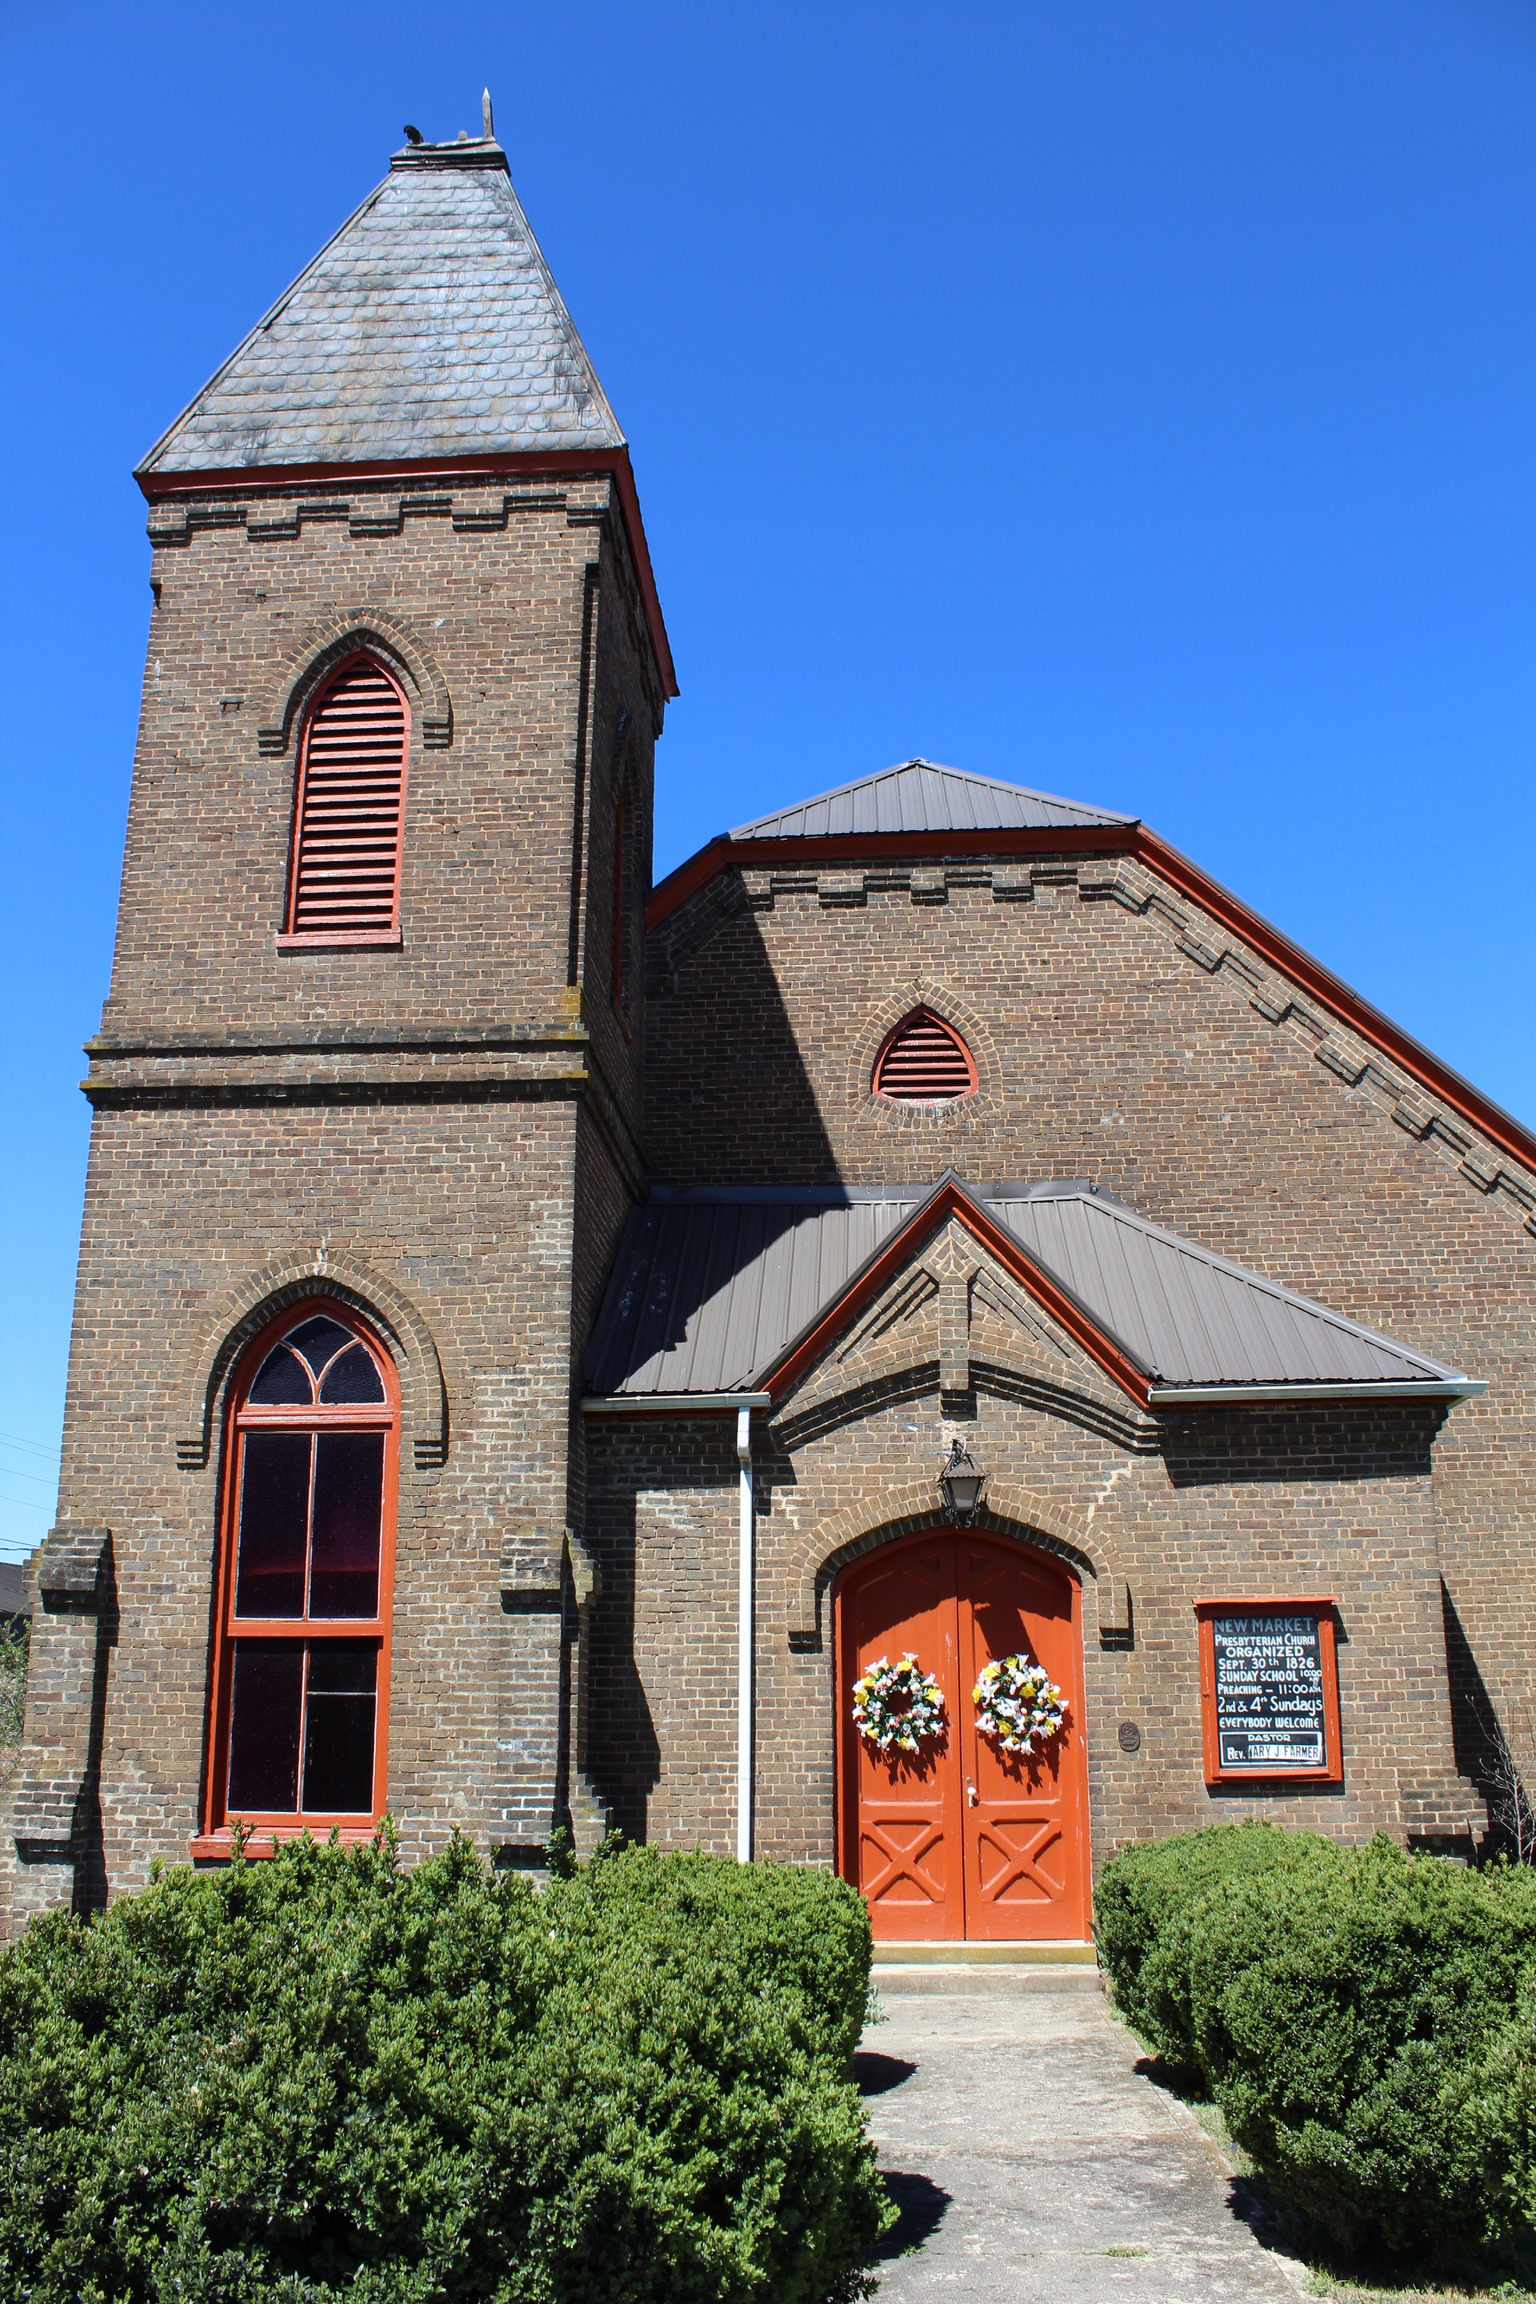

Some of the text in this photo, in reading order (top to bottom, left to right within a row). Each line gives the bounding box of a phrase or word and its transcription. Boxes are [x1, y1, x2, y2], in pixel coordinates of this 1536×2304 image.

[1214, 1618, 1313, 1632] NEW MARKET
[1215, 1633, 1315, 1646] PRESBYTERIAN CHURCH
[1226, 1646, 1304, 1657] ORGANIZED
[1219, 1658, 1247, 1669] SEPT.
[1287, 1657, 1315, 1669] 1826
[1219, 1671, 1258, 1682] SUNDAY
[1260, 1670, 1299, 1681] SCHOOL
[1217, 1683, 1262, 1694] PREACHING
[1279, 1684, 1308, 1694] 11:00
[1237, 1701, 1248, 1713] &
[1270, 1696, 1323, 1716] Sundays
[1247, 1734, 1291, 1742] PASTOR
[1283, 1746, 1319, 1759] FARMER
